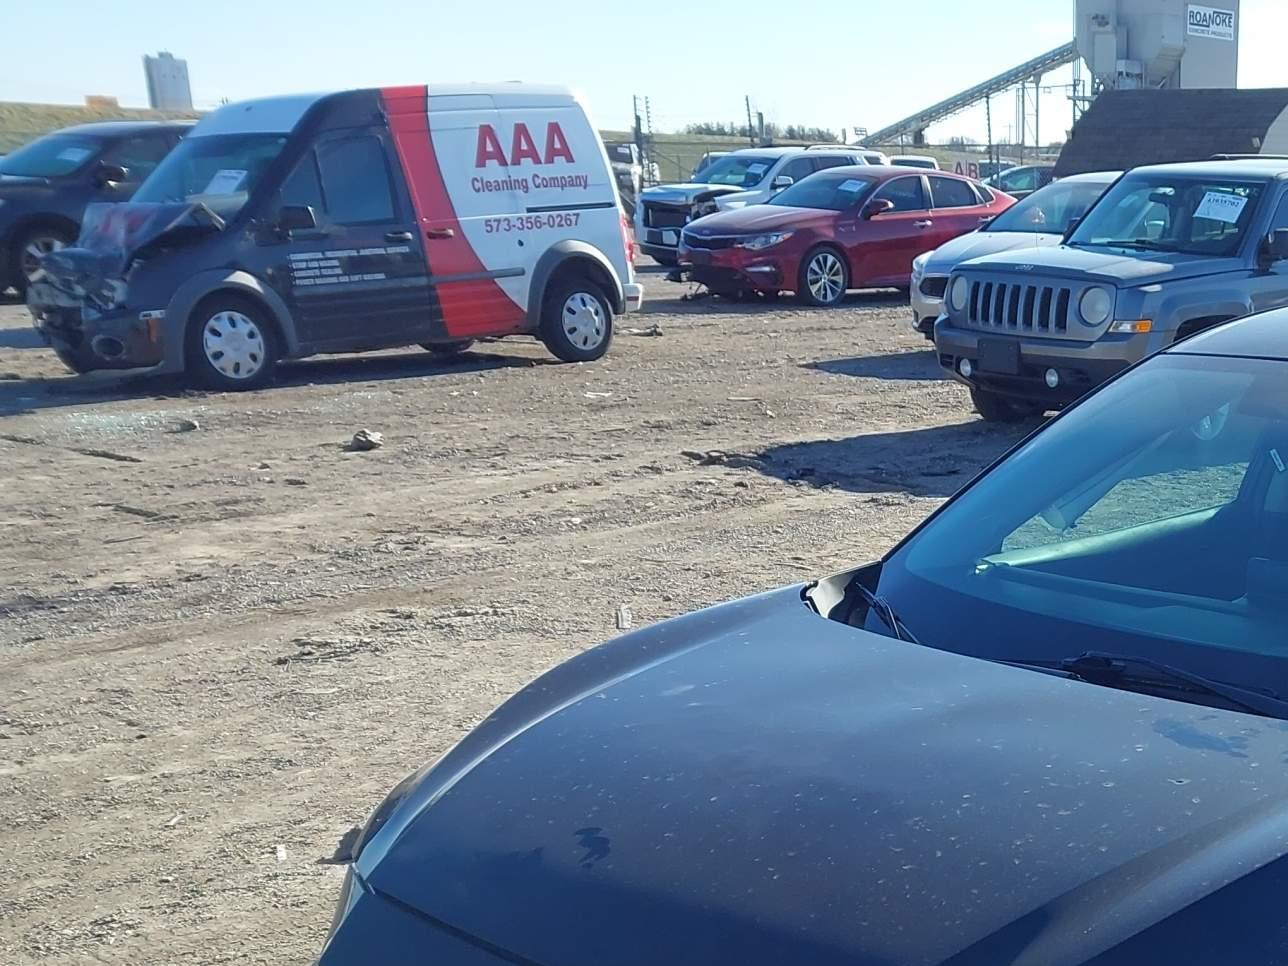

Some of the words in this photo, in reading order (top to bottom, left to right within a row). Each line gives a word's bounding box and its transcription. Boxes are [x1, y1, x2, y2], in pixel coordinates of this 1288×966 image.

[1189, 10, 1233, 28] ROANOKE
[475, 121, 575, 168] AAA
[471, 174, 529, 193] Cleaning
[532, 173, 588, 190] Company
[484, 213, 580, 233] 573-356-0267
